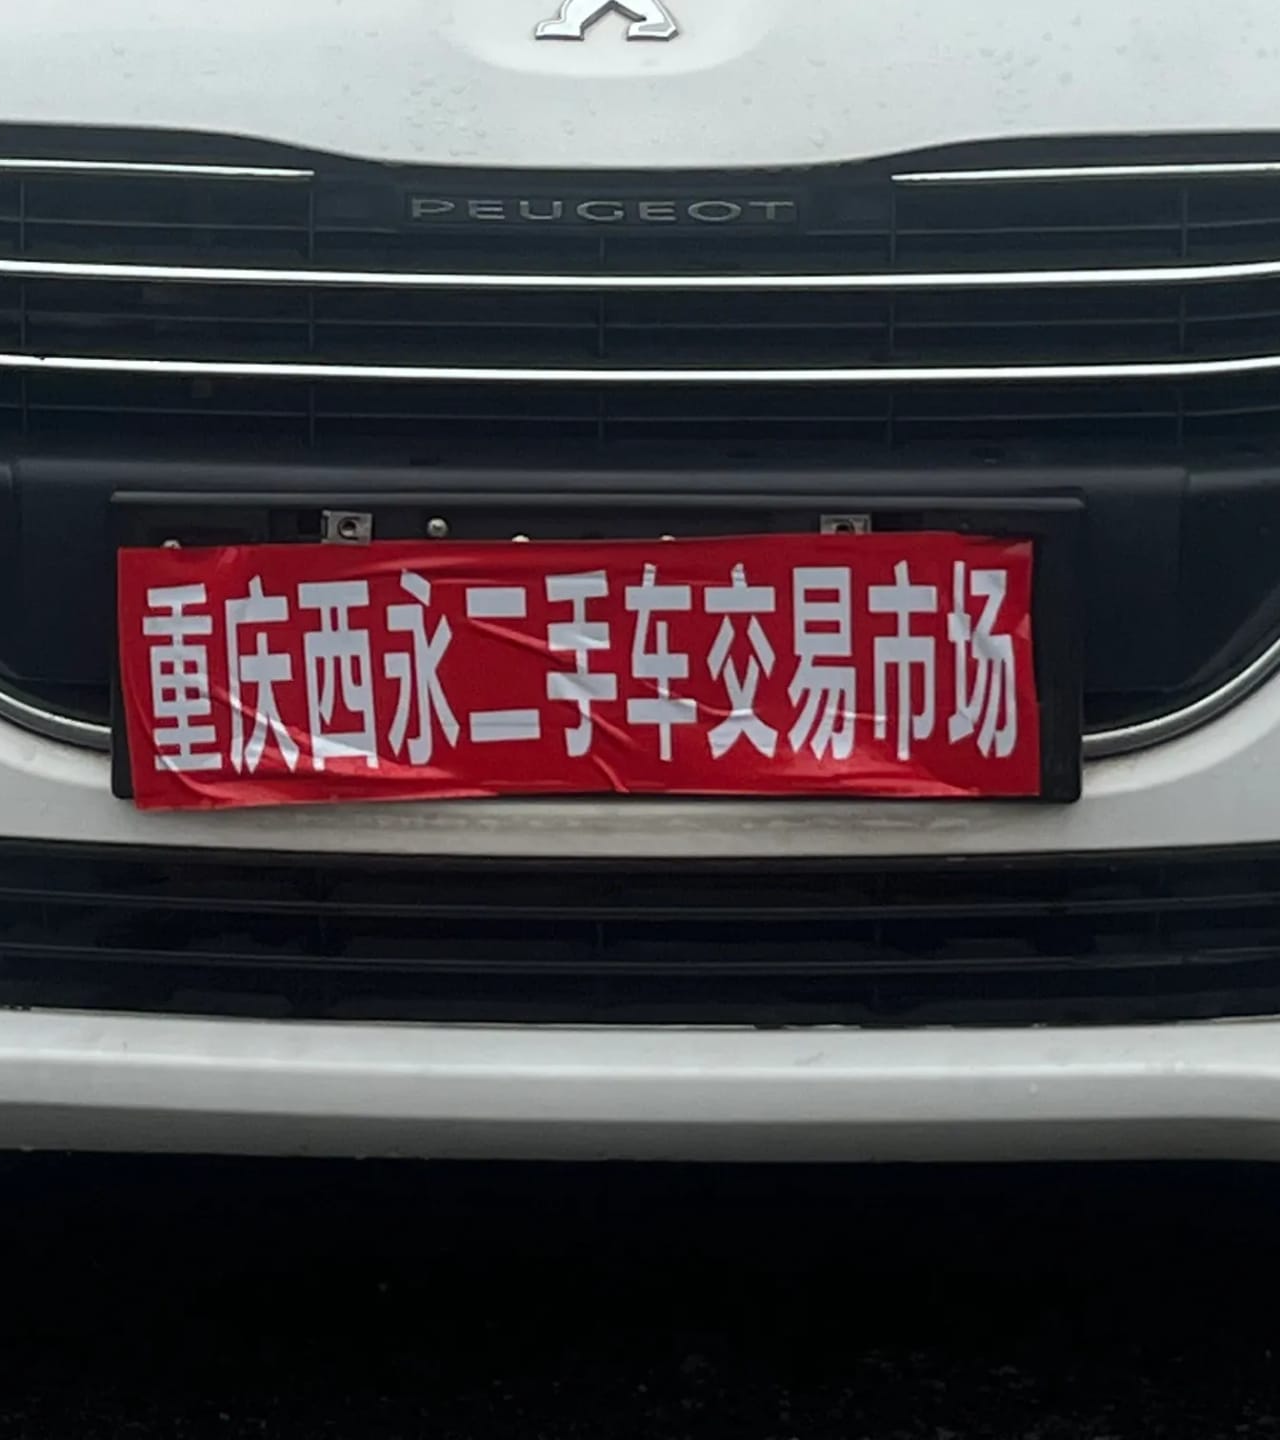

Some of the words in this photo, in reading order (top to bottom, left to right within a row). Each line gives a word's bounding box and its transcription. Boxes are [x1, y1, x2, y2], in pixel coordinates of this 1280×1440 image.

[410, 197, 795, 222] PEUGEOT
[142, 560, 1017, 774] 重庆西永二手车交易市场
